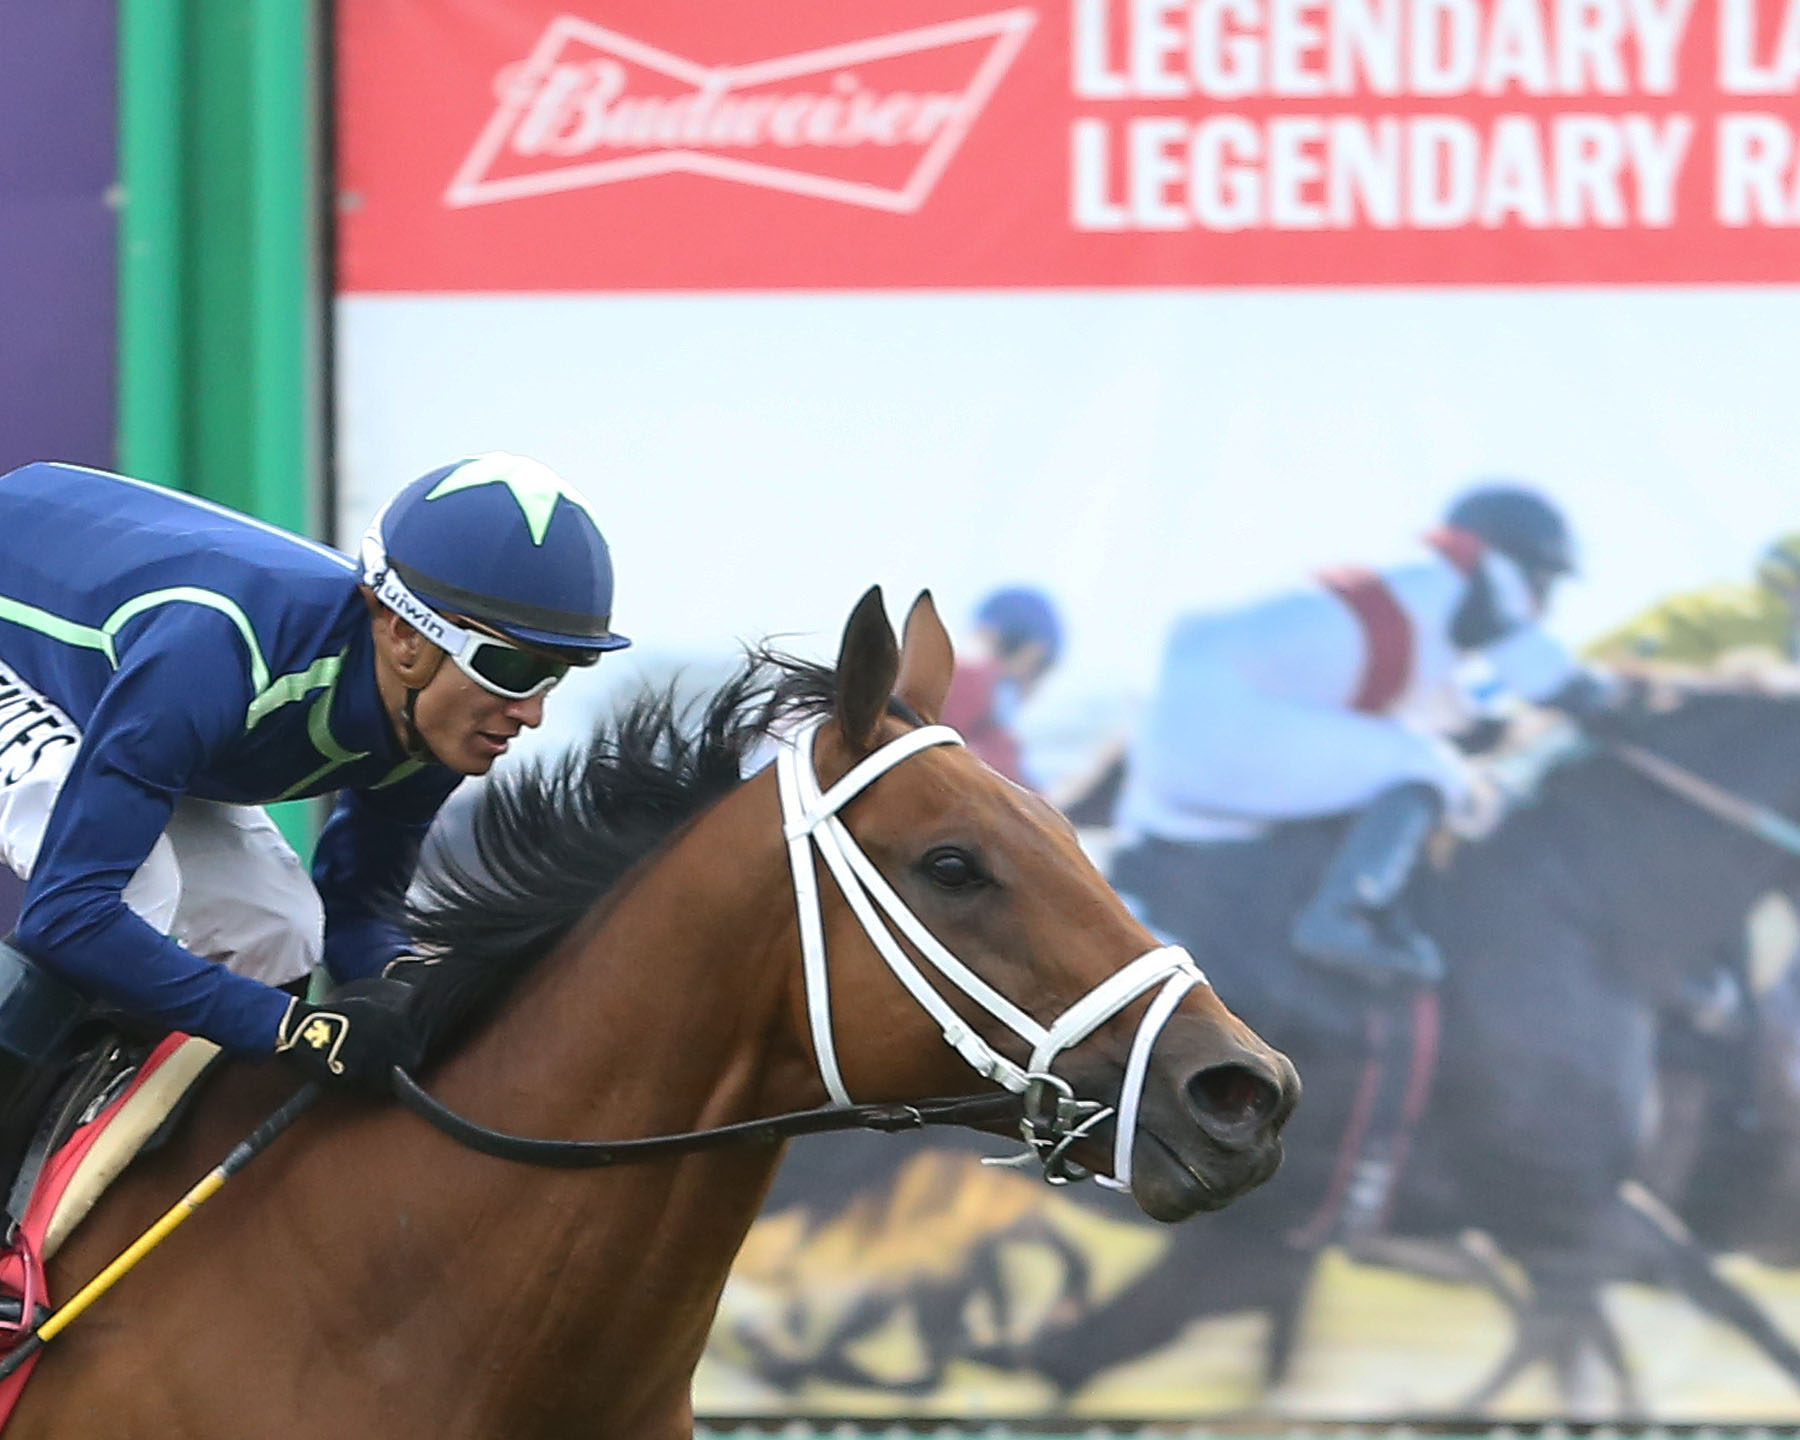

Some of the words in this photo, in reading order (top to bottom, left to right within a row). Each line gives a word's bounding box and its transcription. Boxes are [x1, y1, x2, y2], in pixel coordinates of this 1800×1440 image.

[1070, 0, 1696, 99] LEGENDARY
[493, 57, 968, 156] Budweiser
[1070, 112, 1696, 232] LEGENDARY
